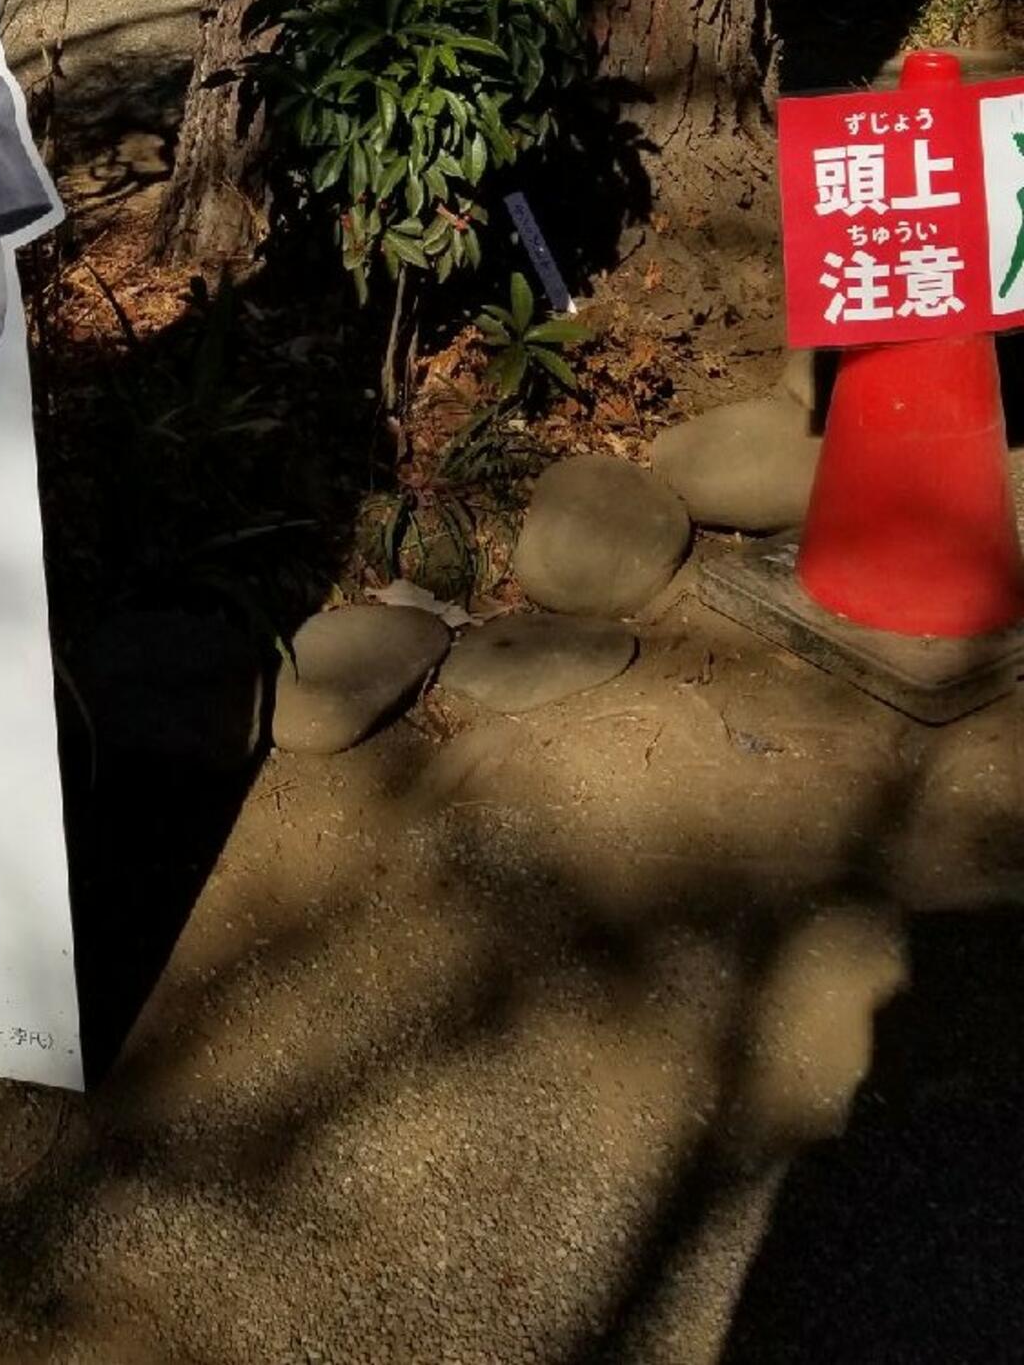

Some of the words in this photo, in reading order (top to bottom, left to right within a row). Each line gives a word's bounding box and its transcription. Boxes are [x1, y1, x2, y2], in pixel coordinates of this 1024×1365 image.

[844, 108, 934, 135] ずじょう
[813, 139, 961, 217] 頭上
[846, 221, 938, 246] ちゅうい
[819, 245, 965, 324] 注意
